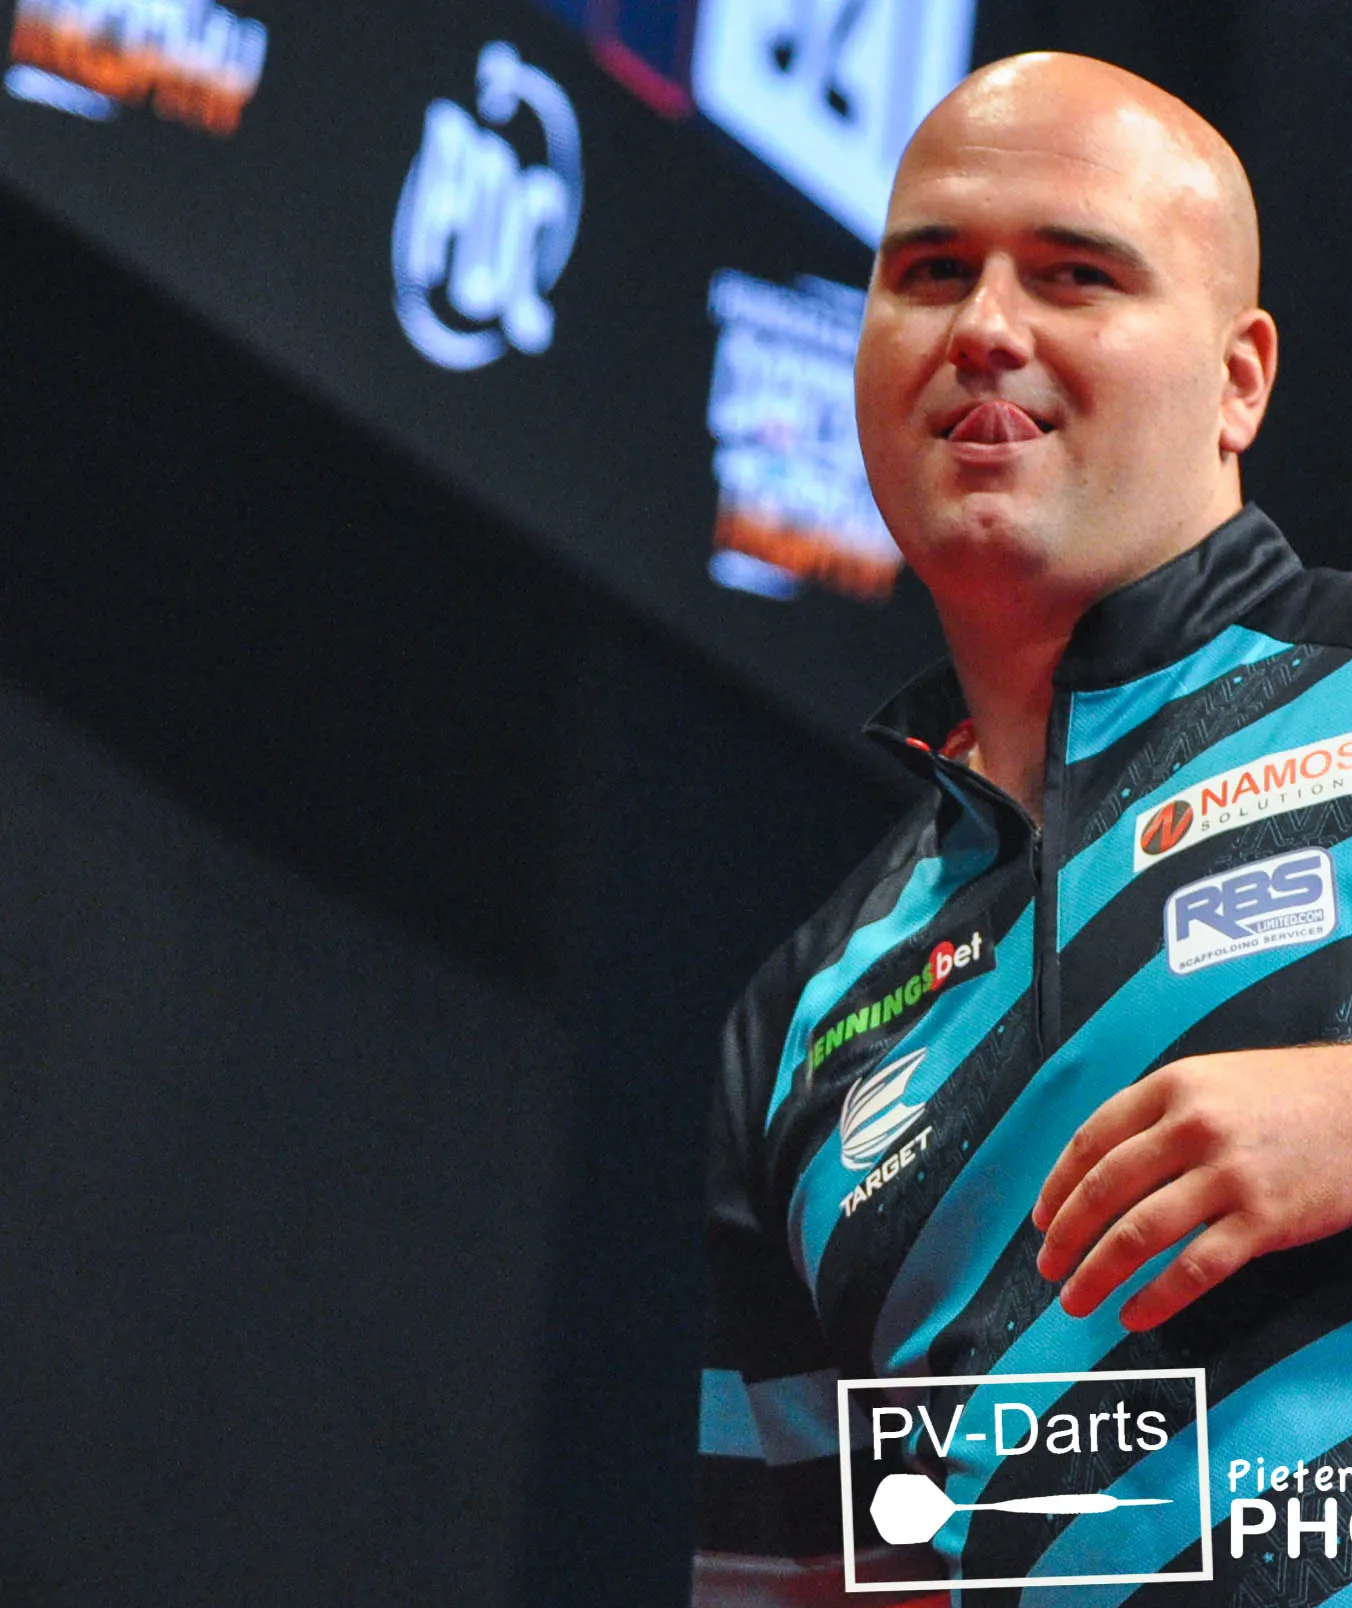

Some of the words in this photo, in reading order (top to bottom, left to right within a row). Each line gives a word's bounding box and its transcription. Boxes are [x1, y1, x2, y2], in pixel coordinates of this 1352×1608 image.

[1175, 855, 1324, 942] RBS
[1179, 939, 1260, 970] SCAFFOLDING
[1263, 926, 1324, 944] SERVICES
[839, 1125, 933, 1217] TARGET
